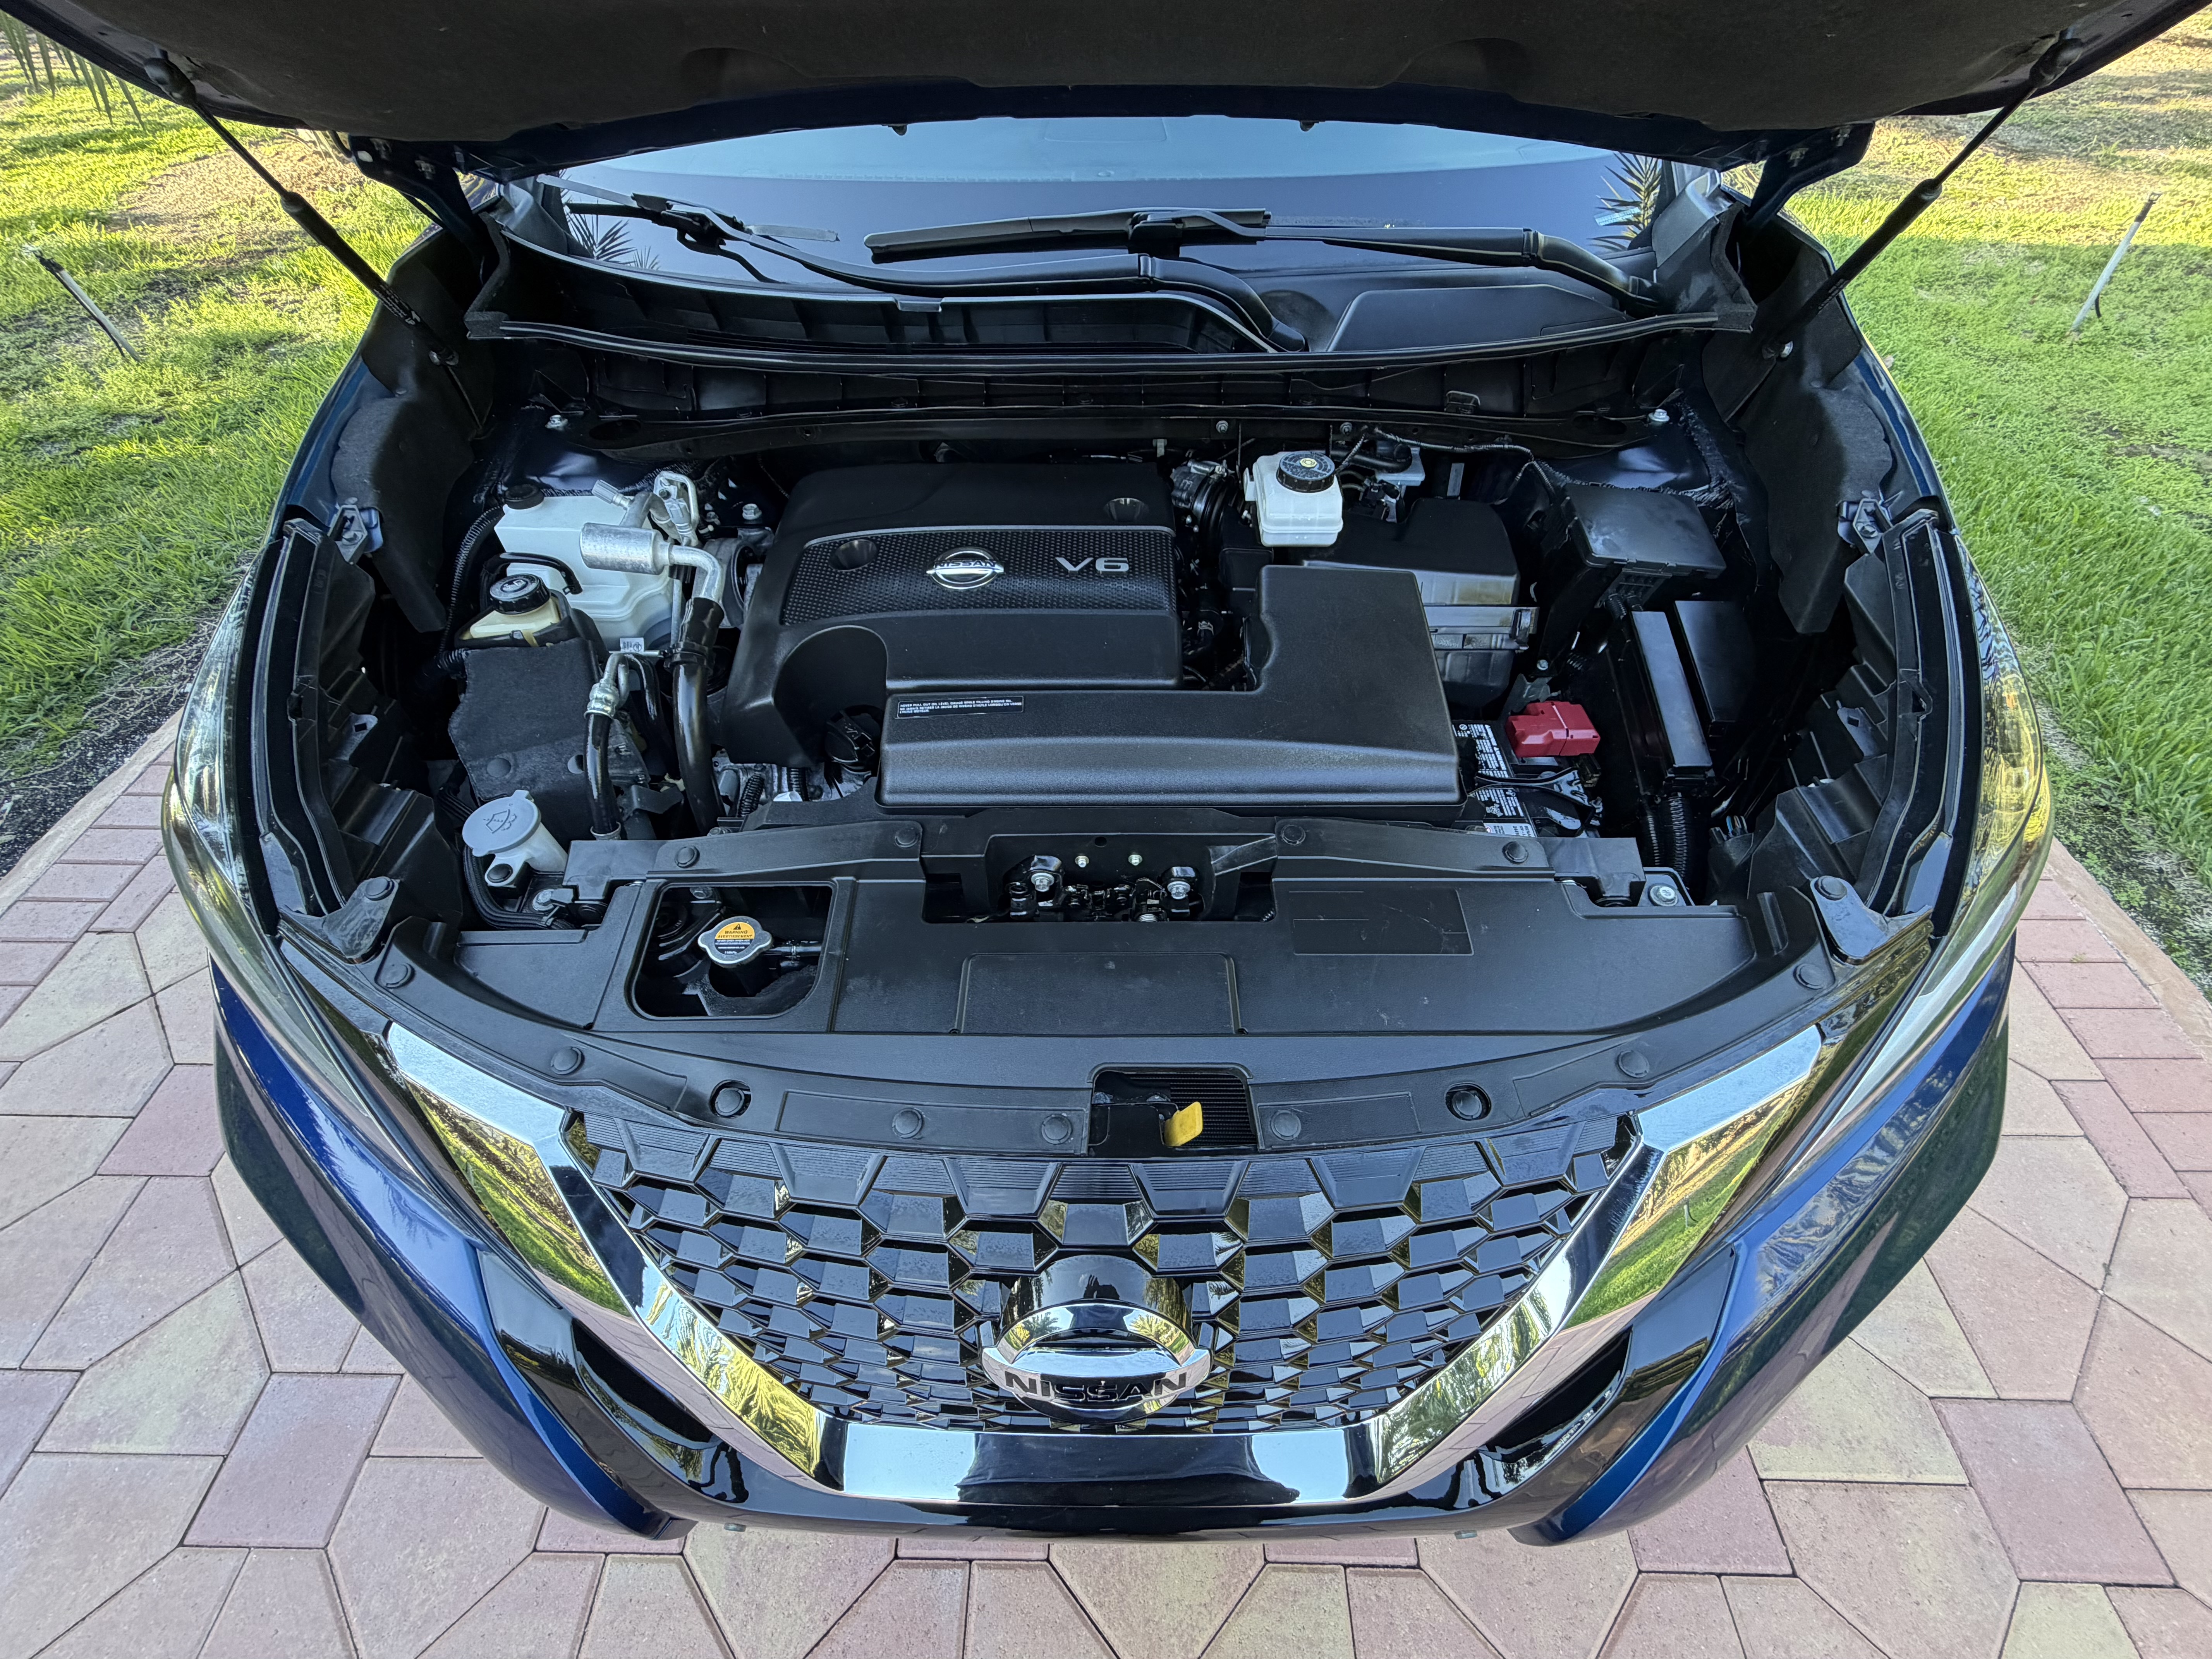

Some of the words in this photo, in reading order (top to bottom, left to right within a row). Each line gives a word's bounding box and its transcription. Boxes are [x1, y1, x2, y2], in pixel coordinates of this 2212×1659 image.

[934, 560, 996, 568] NISSAN
[1055, 557, 1129, 572] V6
[1005, 1370, 1187, 1402] NISSAN
